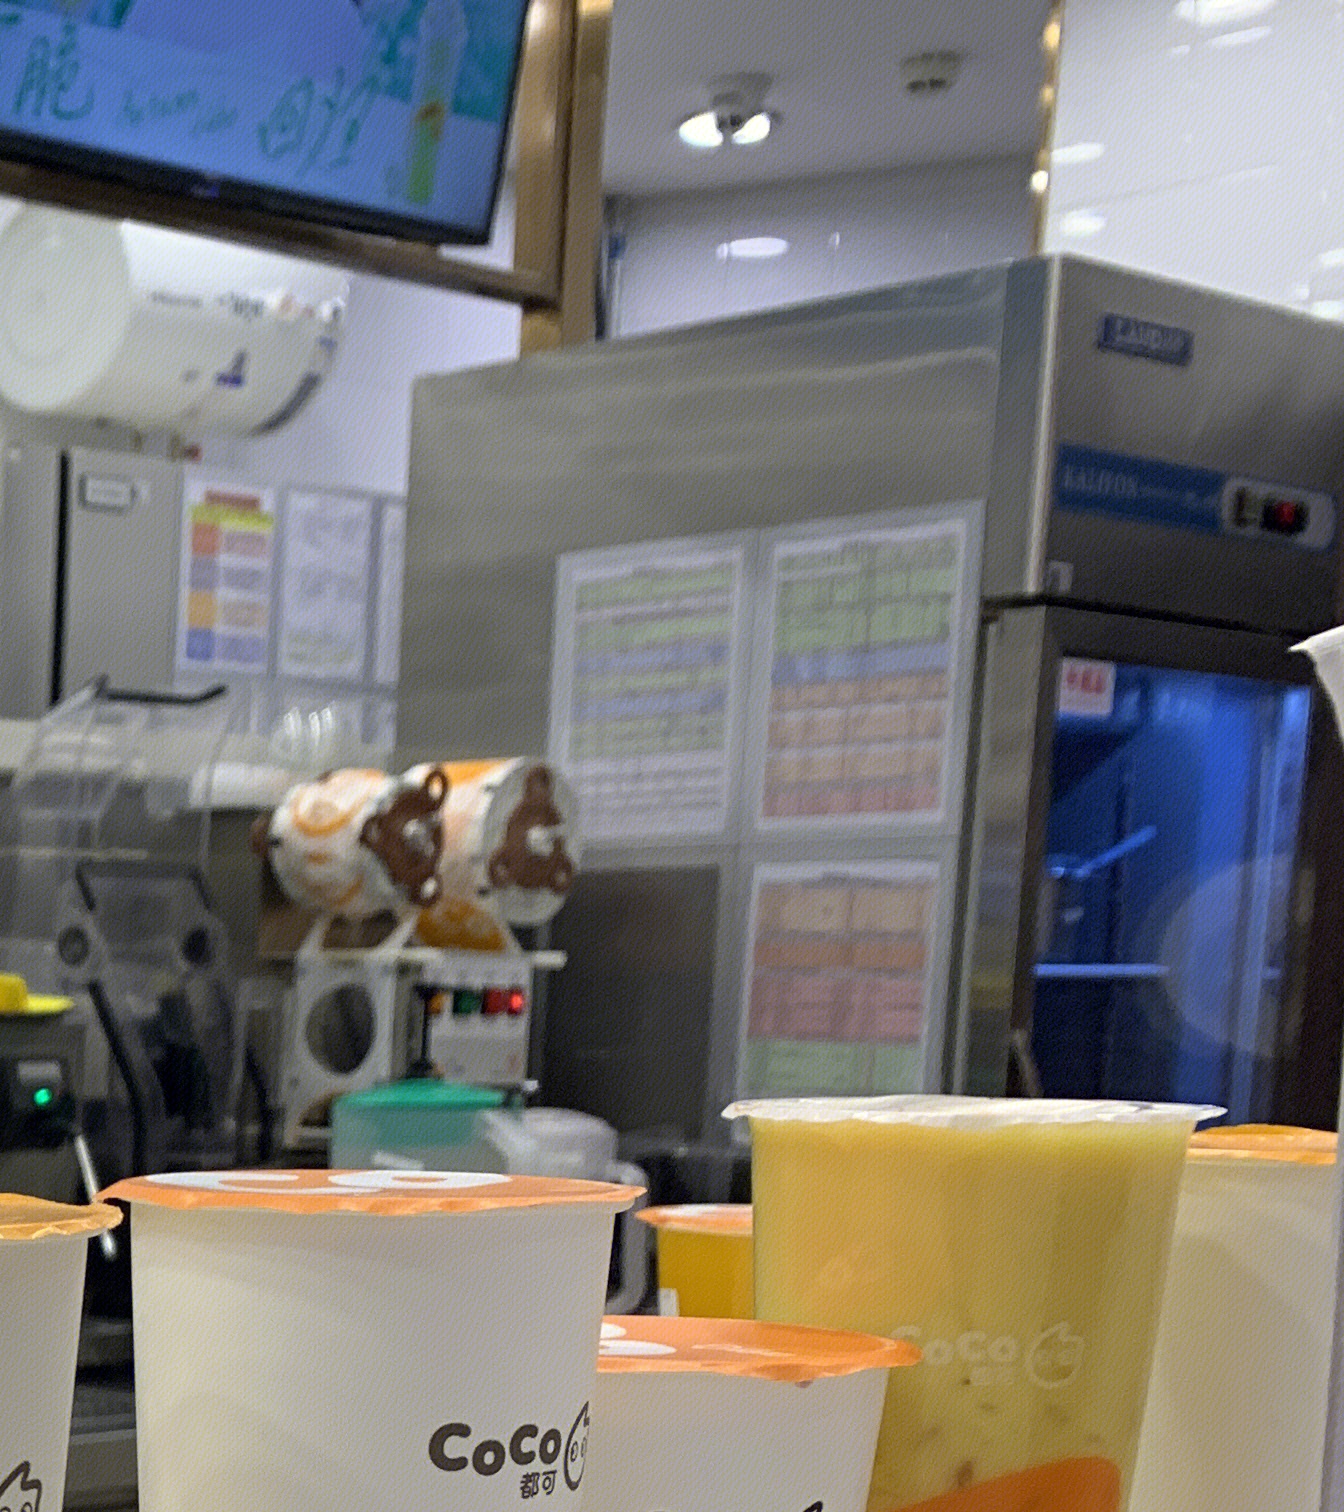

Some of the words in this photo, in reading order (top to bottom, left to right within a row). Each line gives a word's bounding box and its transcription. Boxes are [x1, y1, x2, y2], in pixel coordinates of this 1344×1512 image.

[890, 1324, 1018, 1367] oCo
[427, 1421, 562, 1476] CoCo
[518, 1469, 558, 1499] 都可
